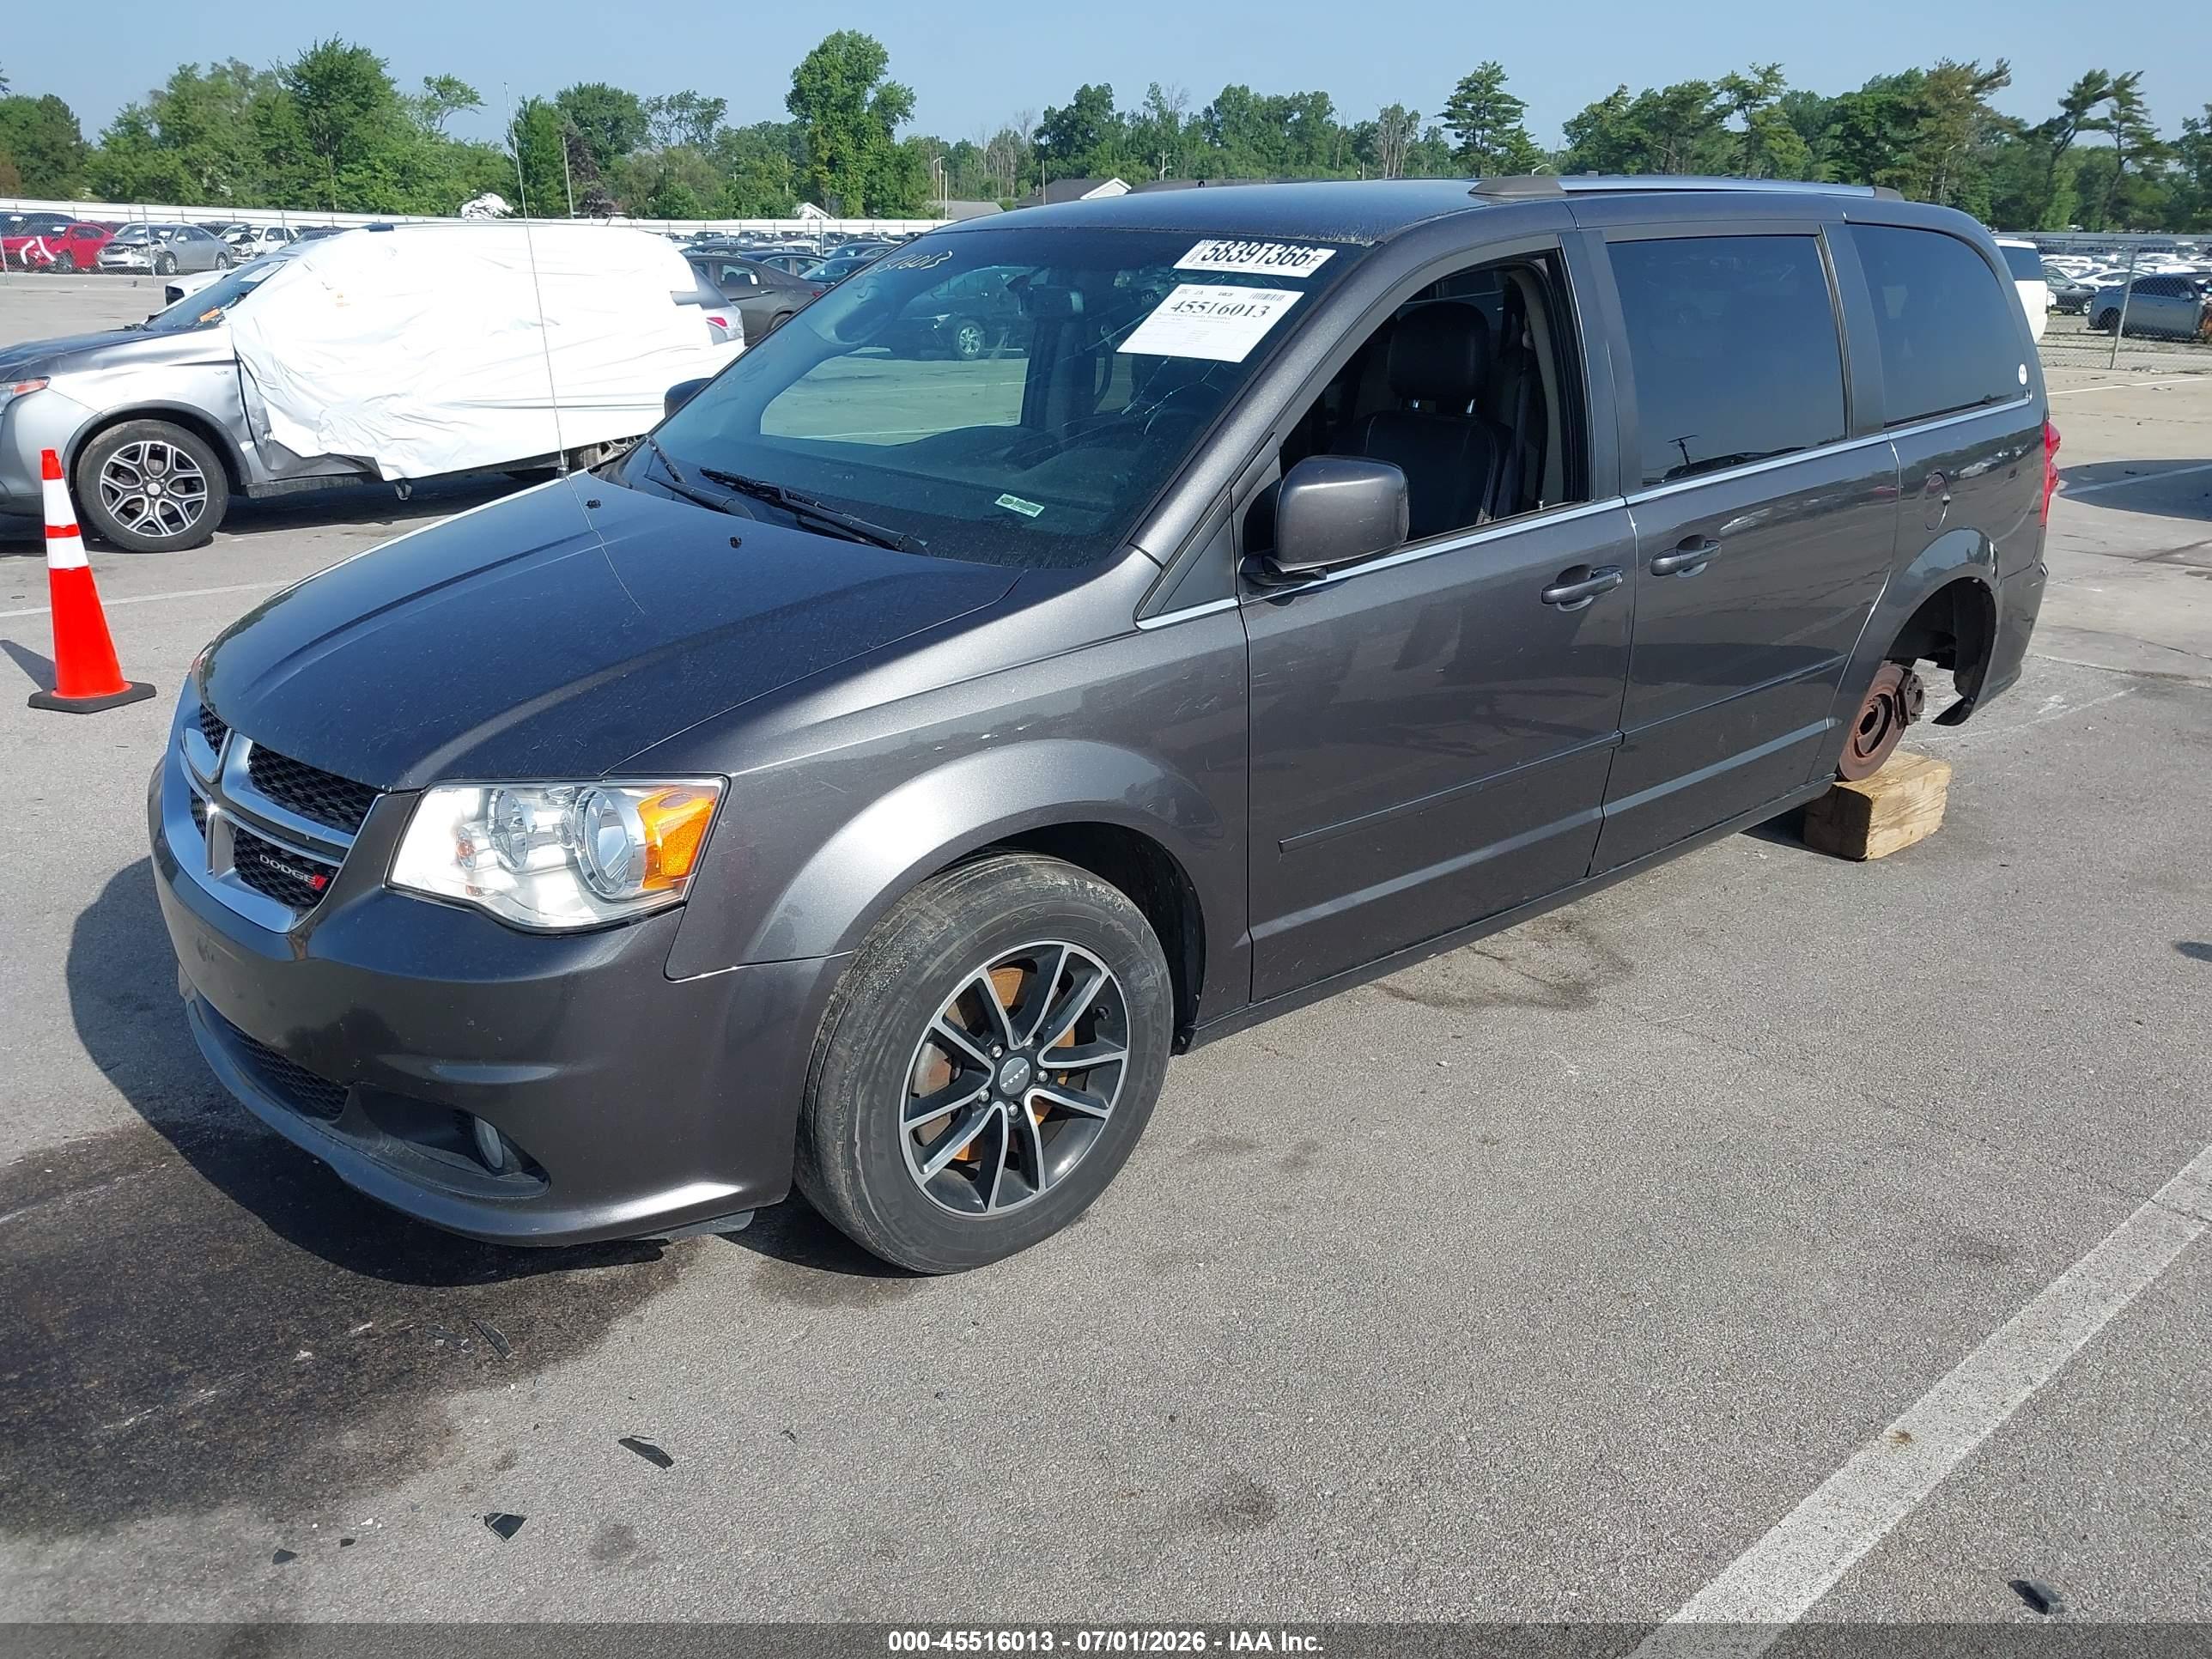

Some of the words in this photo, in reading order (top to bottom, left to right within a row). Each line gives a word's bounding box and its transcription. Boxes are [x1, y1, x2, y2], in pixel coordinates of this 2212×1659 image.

[1202, 241, 1312, 266] 58391366
[1170, 300, 1270, 318] 45516013
[259, 854, 316, 886] DODGE
